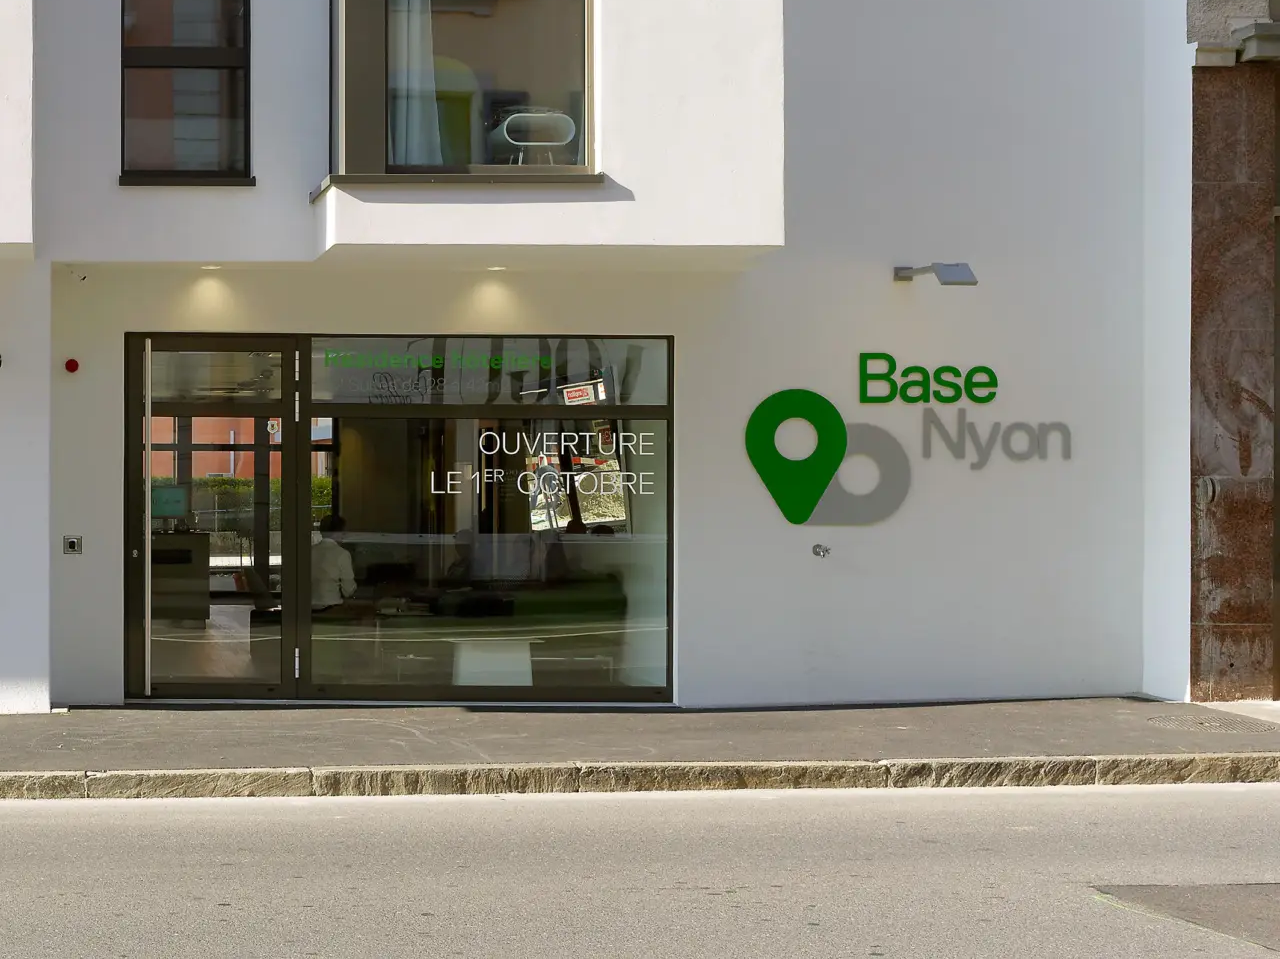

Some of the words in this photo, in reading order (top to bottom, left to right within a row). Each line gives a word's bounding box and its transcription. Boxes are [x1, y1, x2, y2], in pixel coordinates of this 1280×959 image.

[859, 352, 999, 404] Base
[478, 431, 655, 456] OUVERTURE
[922, 407, 1072, 470] Nyon
[430, 470, 463, 494] LE
[516, 470, 655, 495] OCTOBRE
